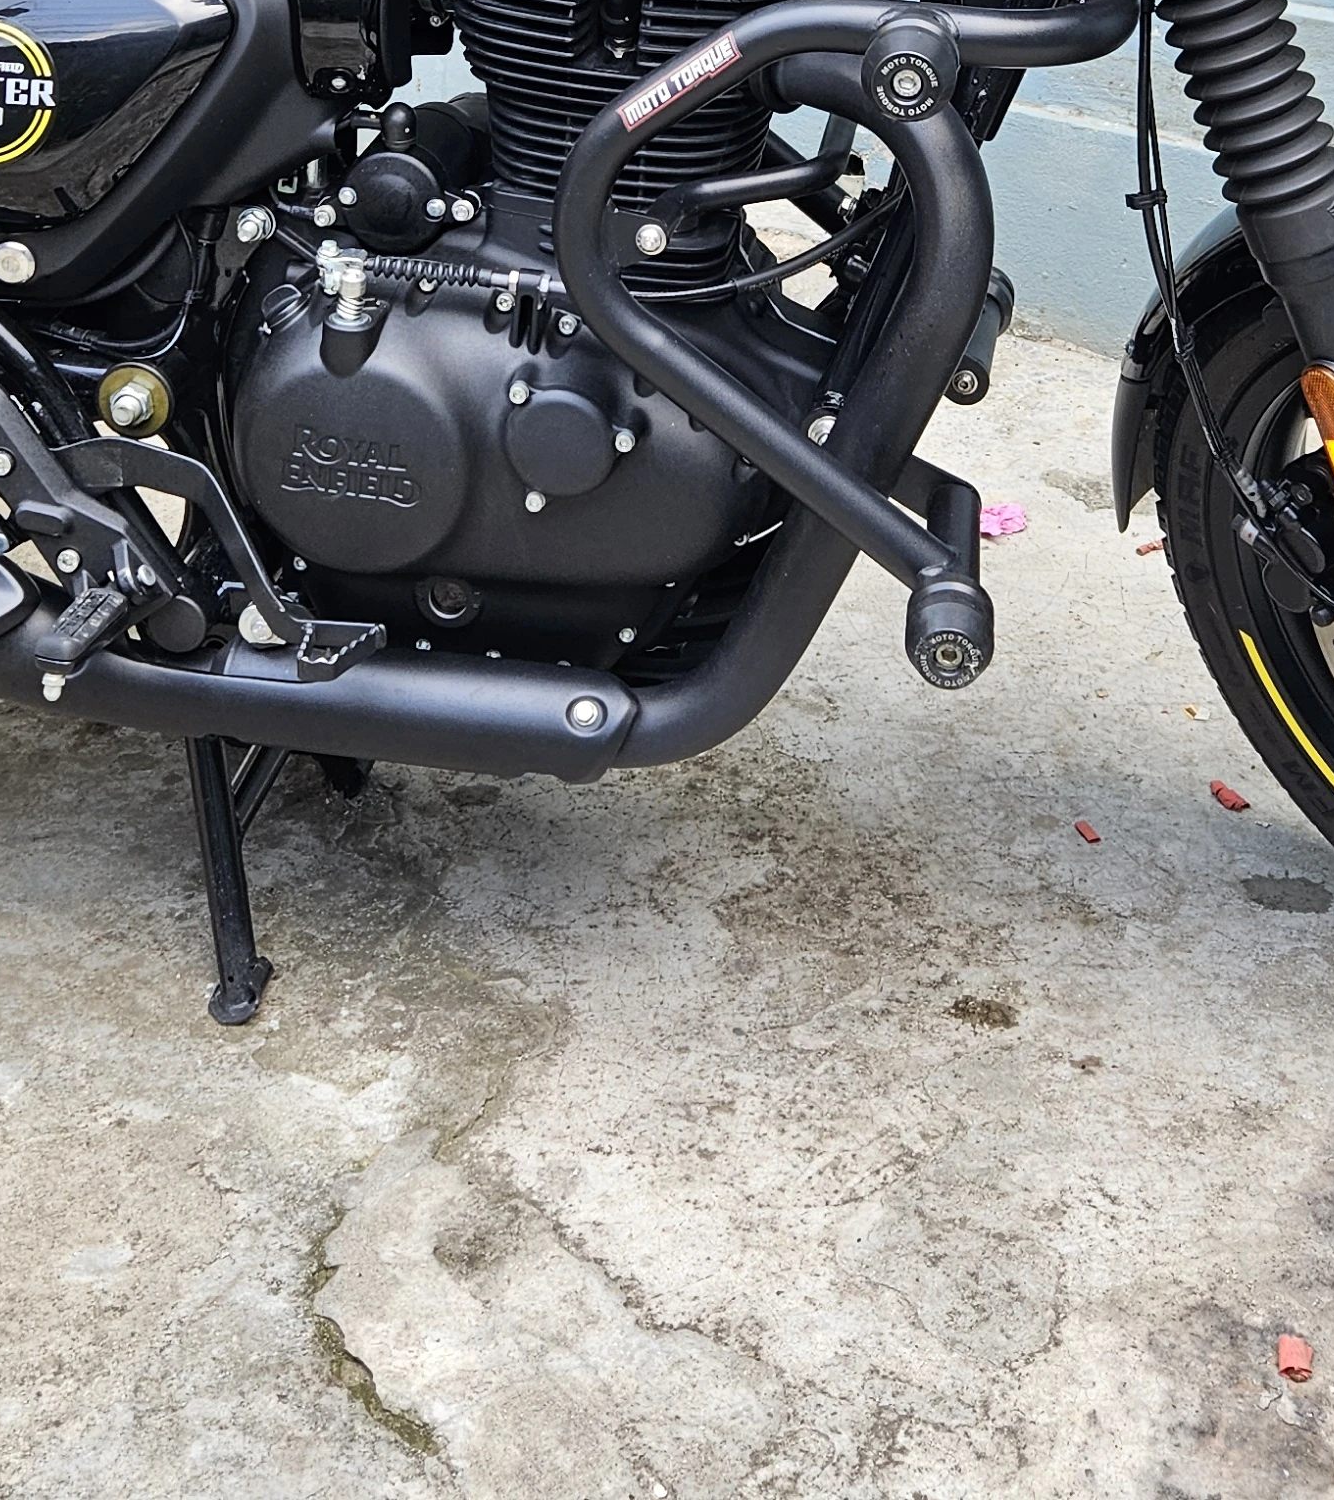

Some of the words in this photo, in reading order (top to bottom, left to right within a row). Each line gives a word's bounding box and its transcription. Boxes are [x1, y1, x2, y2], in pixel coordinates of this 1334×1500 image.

[622, 79, 673, 125] MOTO
[670, 37, 738, 92] TORQUE
[880, 56, 907, 76] MOTO
[909, 56, 939, 88] TORQUE
[876, 85, 906, 117] TORQUE
[907, 97, 935, 117] MOTO
[292, 422, 408, 473] ROYAL
[280, 461, 423, 508] ENFIELD
[919, 654, 942, 685] TORQUE
